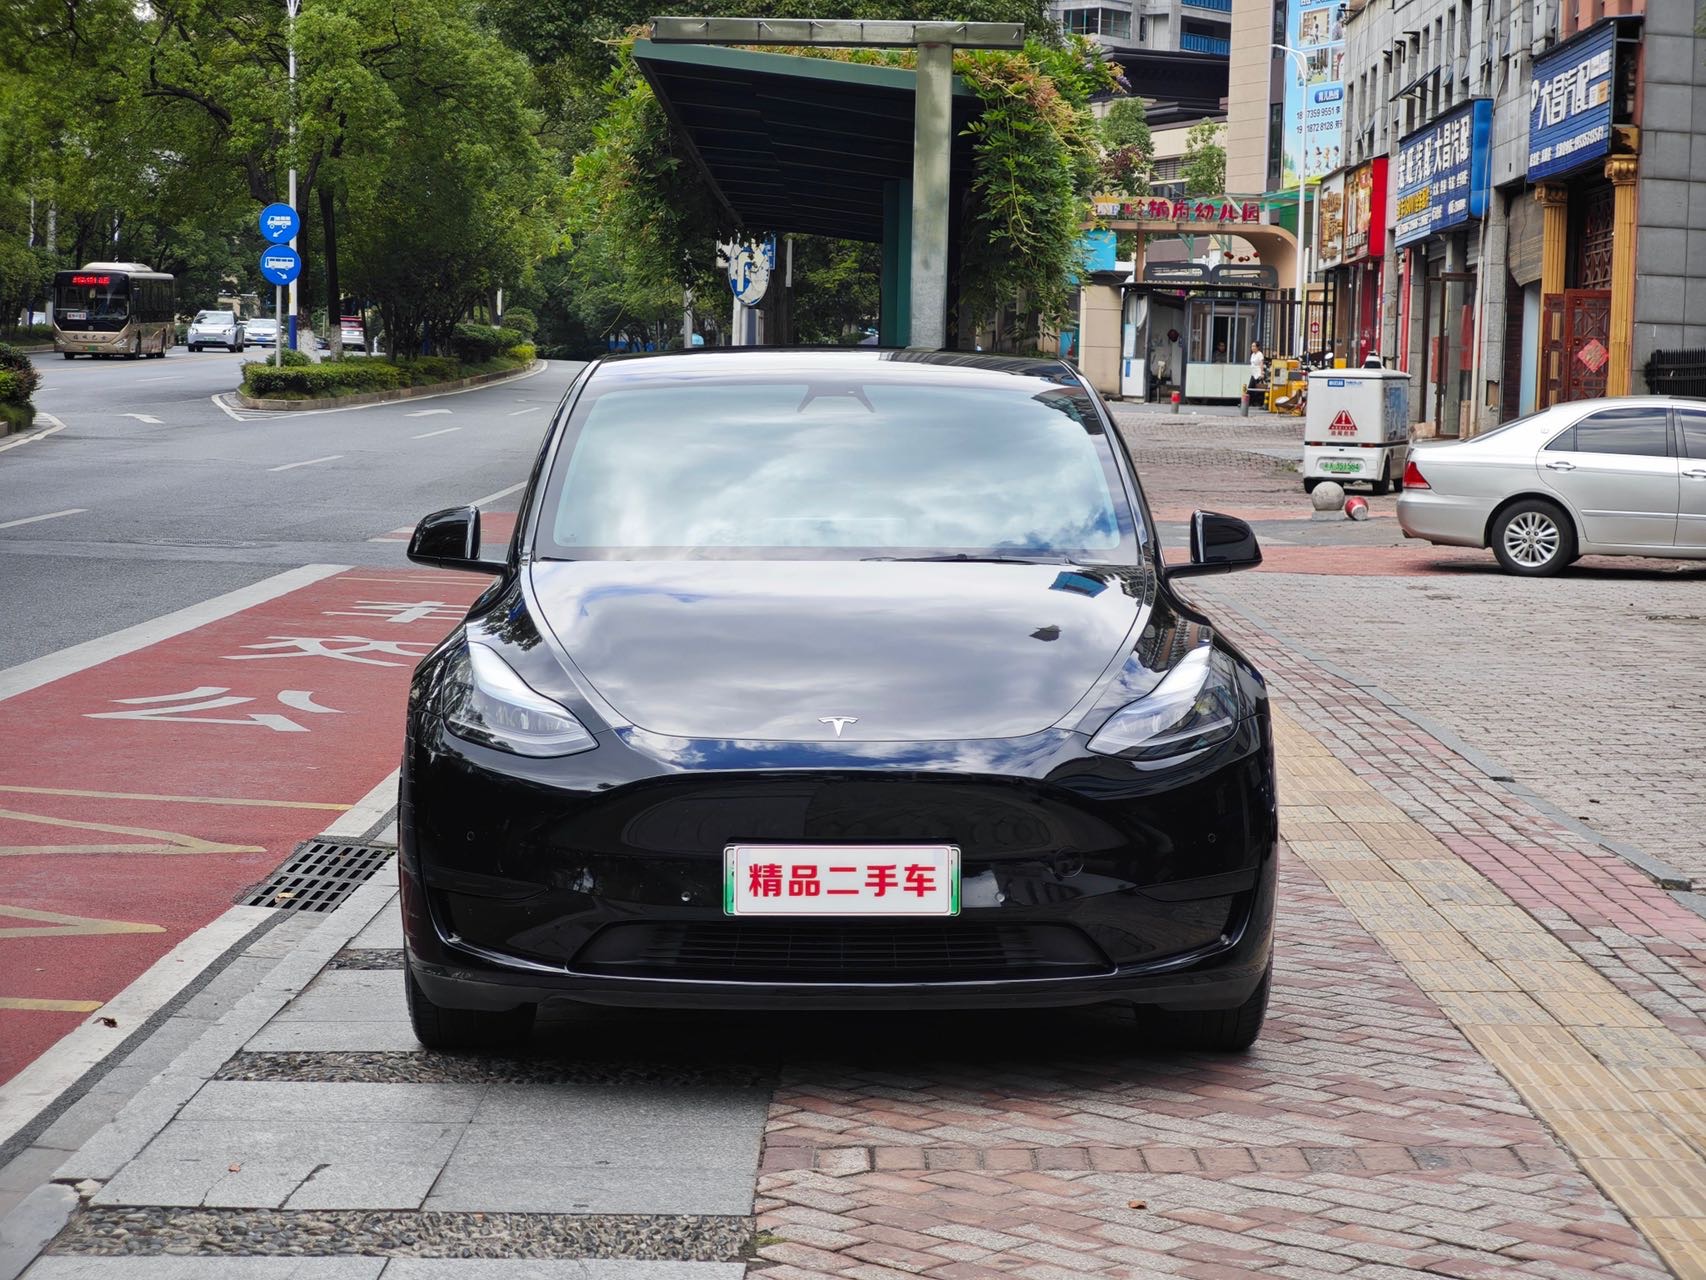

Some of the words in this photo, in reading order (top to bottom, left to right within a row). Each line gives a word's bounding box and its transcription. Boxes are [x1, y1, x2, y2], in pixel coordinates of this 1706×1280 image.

[1539, 62, 1591, 130] 大昌汽配
[1433, 114, 1471, 173] 大昌汽配
[748, 863, 938, 898] 精品二手车
